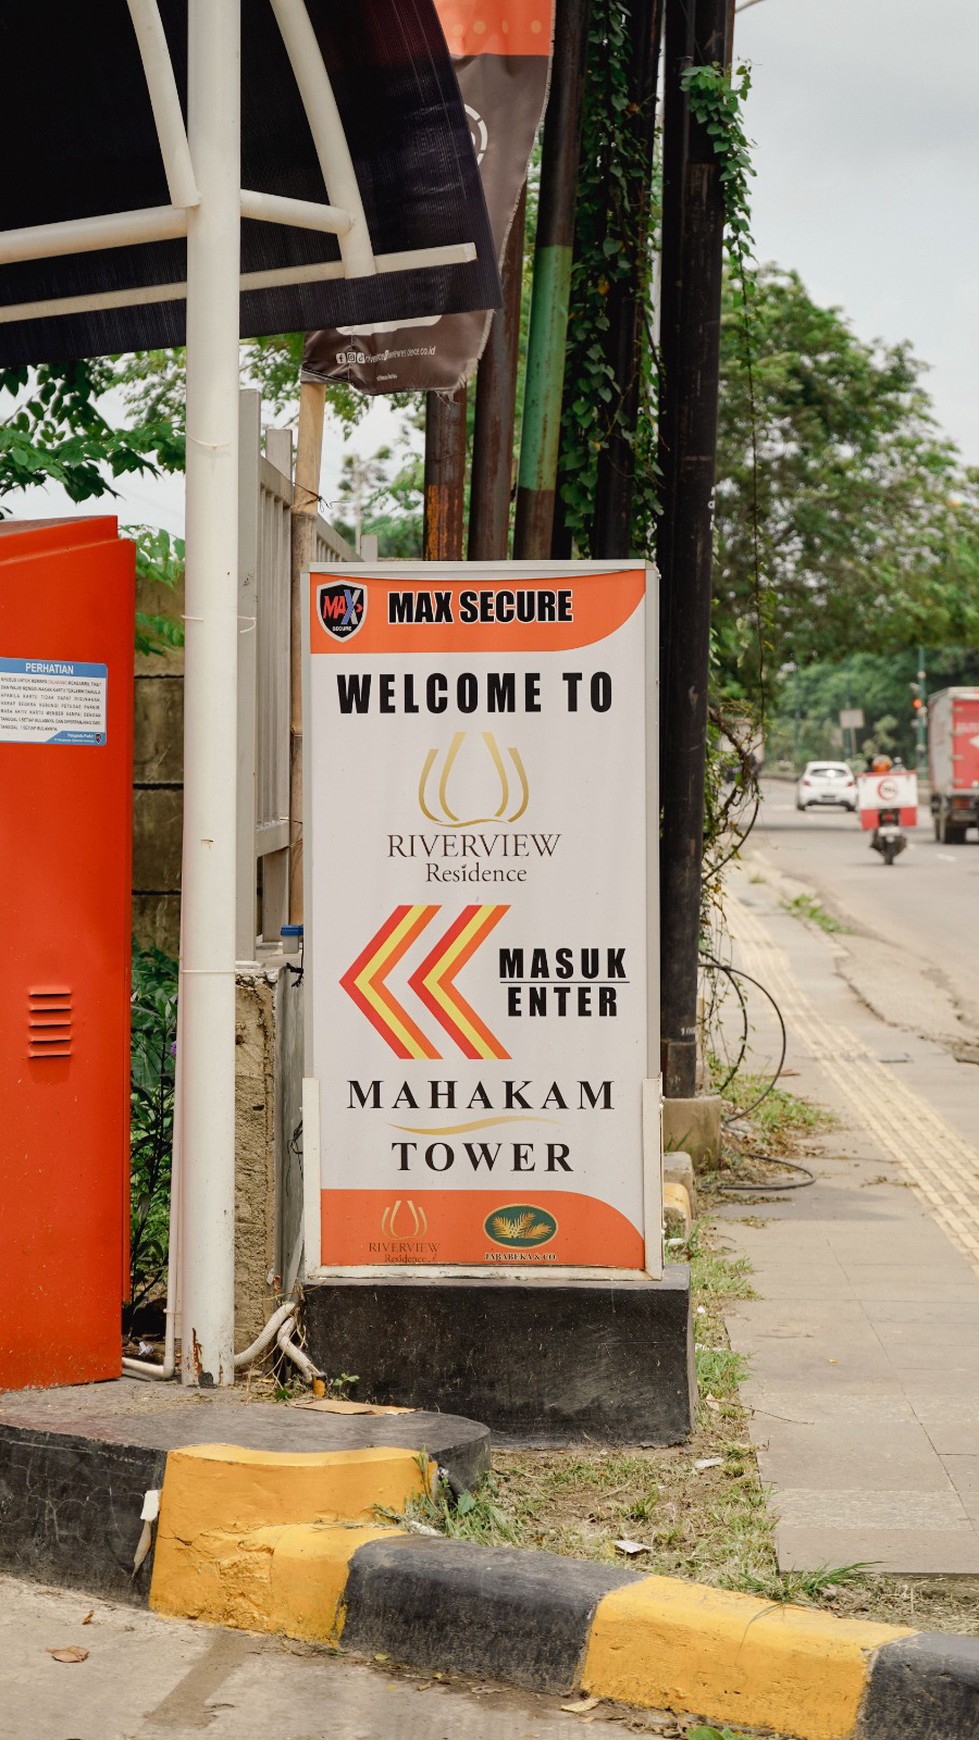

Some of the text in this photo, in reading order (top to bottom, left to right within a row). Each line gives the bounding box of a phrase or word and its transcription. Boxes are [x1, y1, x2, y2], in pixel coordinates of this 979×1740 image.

[323, 589, 362, 625] MAX
[387, 589, 574, 624] MAX SECURE
[25, 662, 74, 675] PERHATIAN
[336, 671, 613, 714] WELCOME TO
[387, 832, 562, 858] RIVERVIEW
[425, 862, 527, 883] Residence
[499, 947, 627, 979] MASUK
[507, 986, 618, 1017] ENTER
[346, 1080, 616, 1110] MAHAKAM
[391, 1142, 574, 1172] TOWER
[368, 1242, 440, 1253] RIVERVIEW
[484, 1252, 532, 1261] JABABEKA
